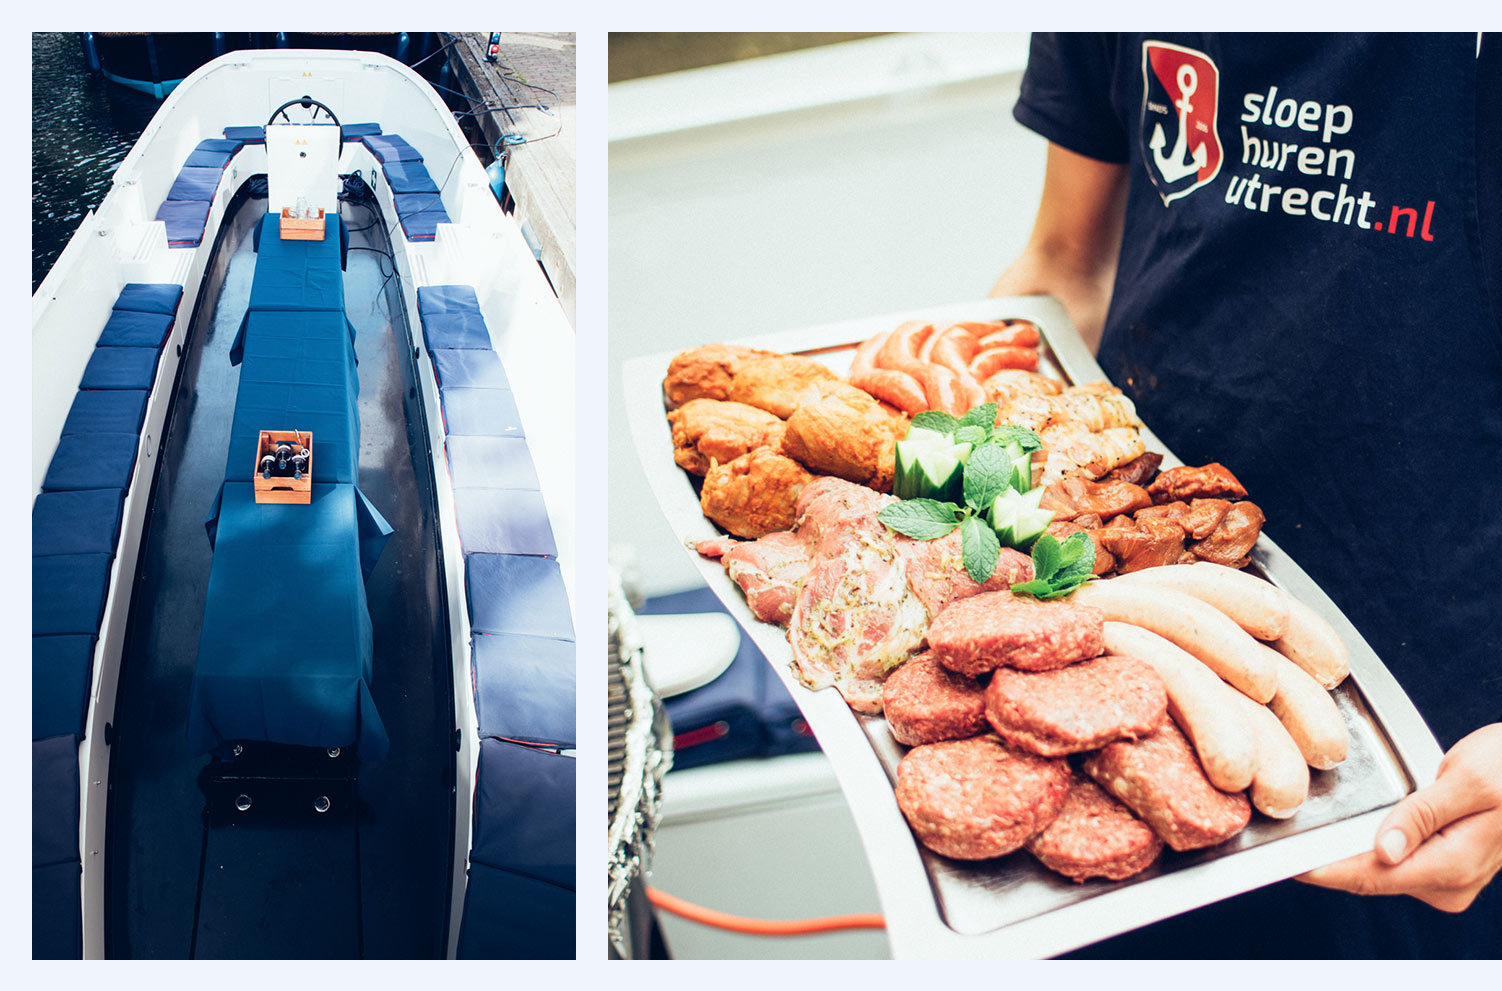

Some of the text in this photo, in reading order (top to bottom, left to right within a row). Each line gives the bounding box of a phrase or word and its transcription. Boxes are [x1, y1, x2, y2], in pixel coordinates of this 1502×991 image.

[1241, 86, 1353, 143] sloep
[1241, 125, 1355, 179] huren
[1224, 173, 1436, 242] utrecht.nl
